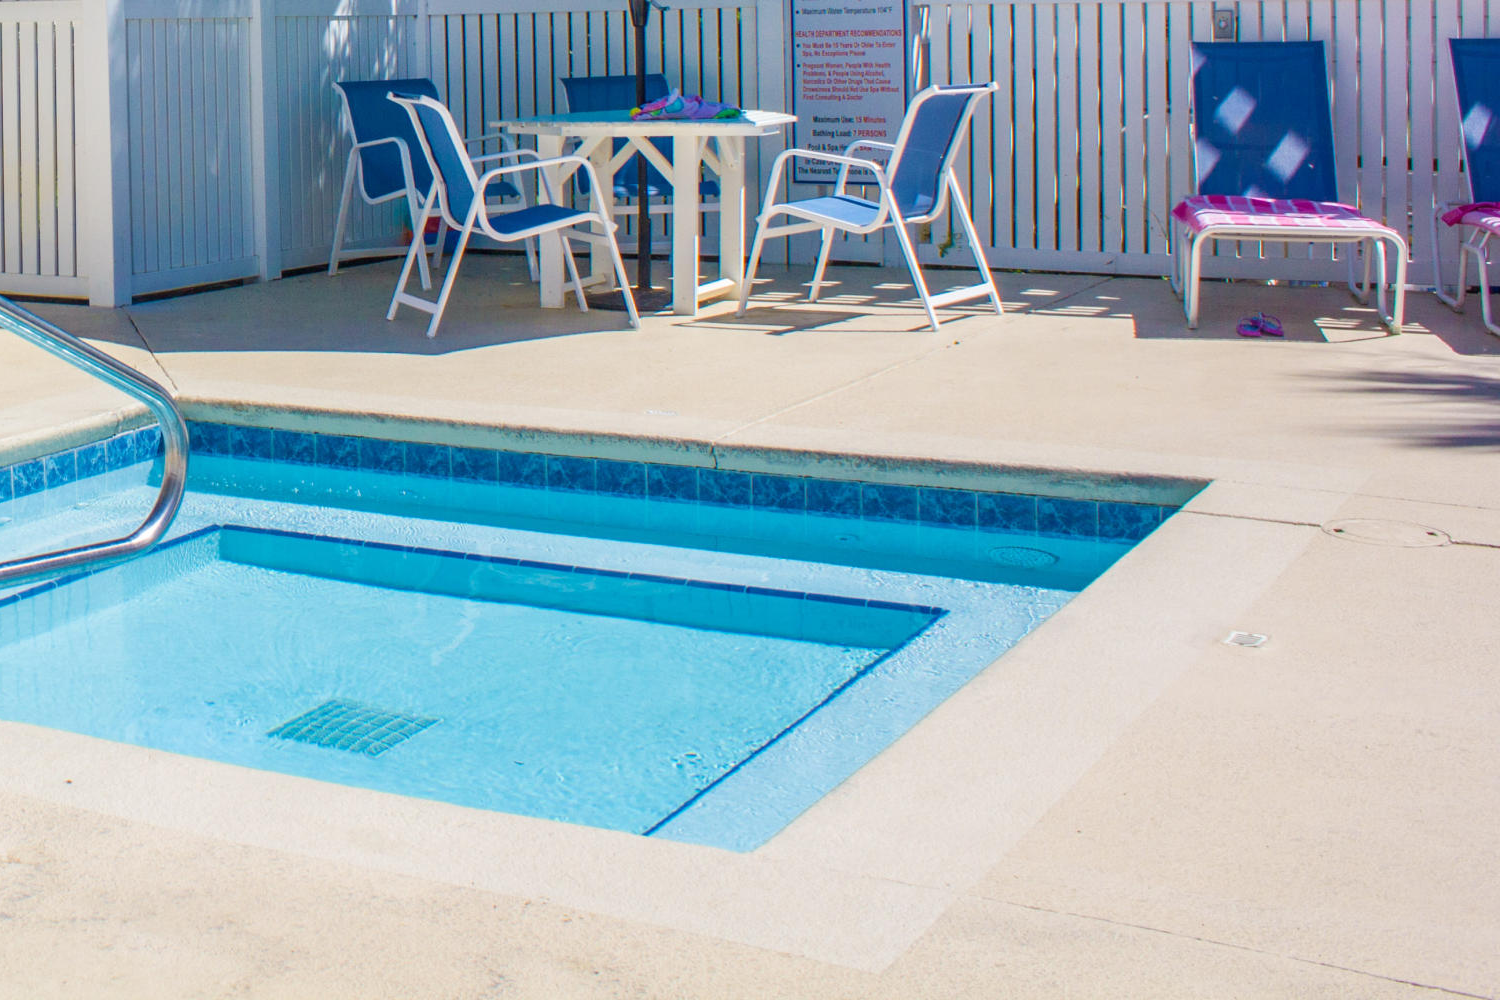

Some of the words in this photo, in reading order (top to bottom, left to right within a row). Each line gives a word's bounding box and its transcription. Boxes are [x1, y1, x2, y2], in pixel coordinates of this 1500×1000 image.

[795, 30, 814, 38] HEALTH
[850, 29, 902, 37] RECOMMENDATIONS
[858, 129, 887, 137] PERSONS
